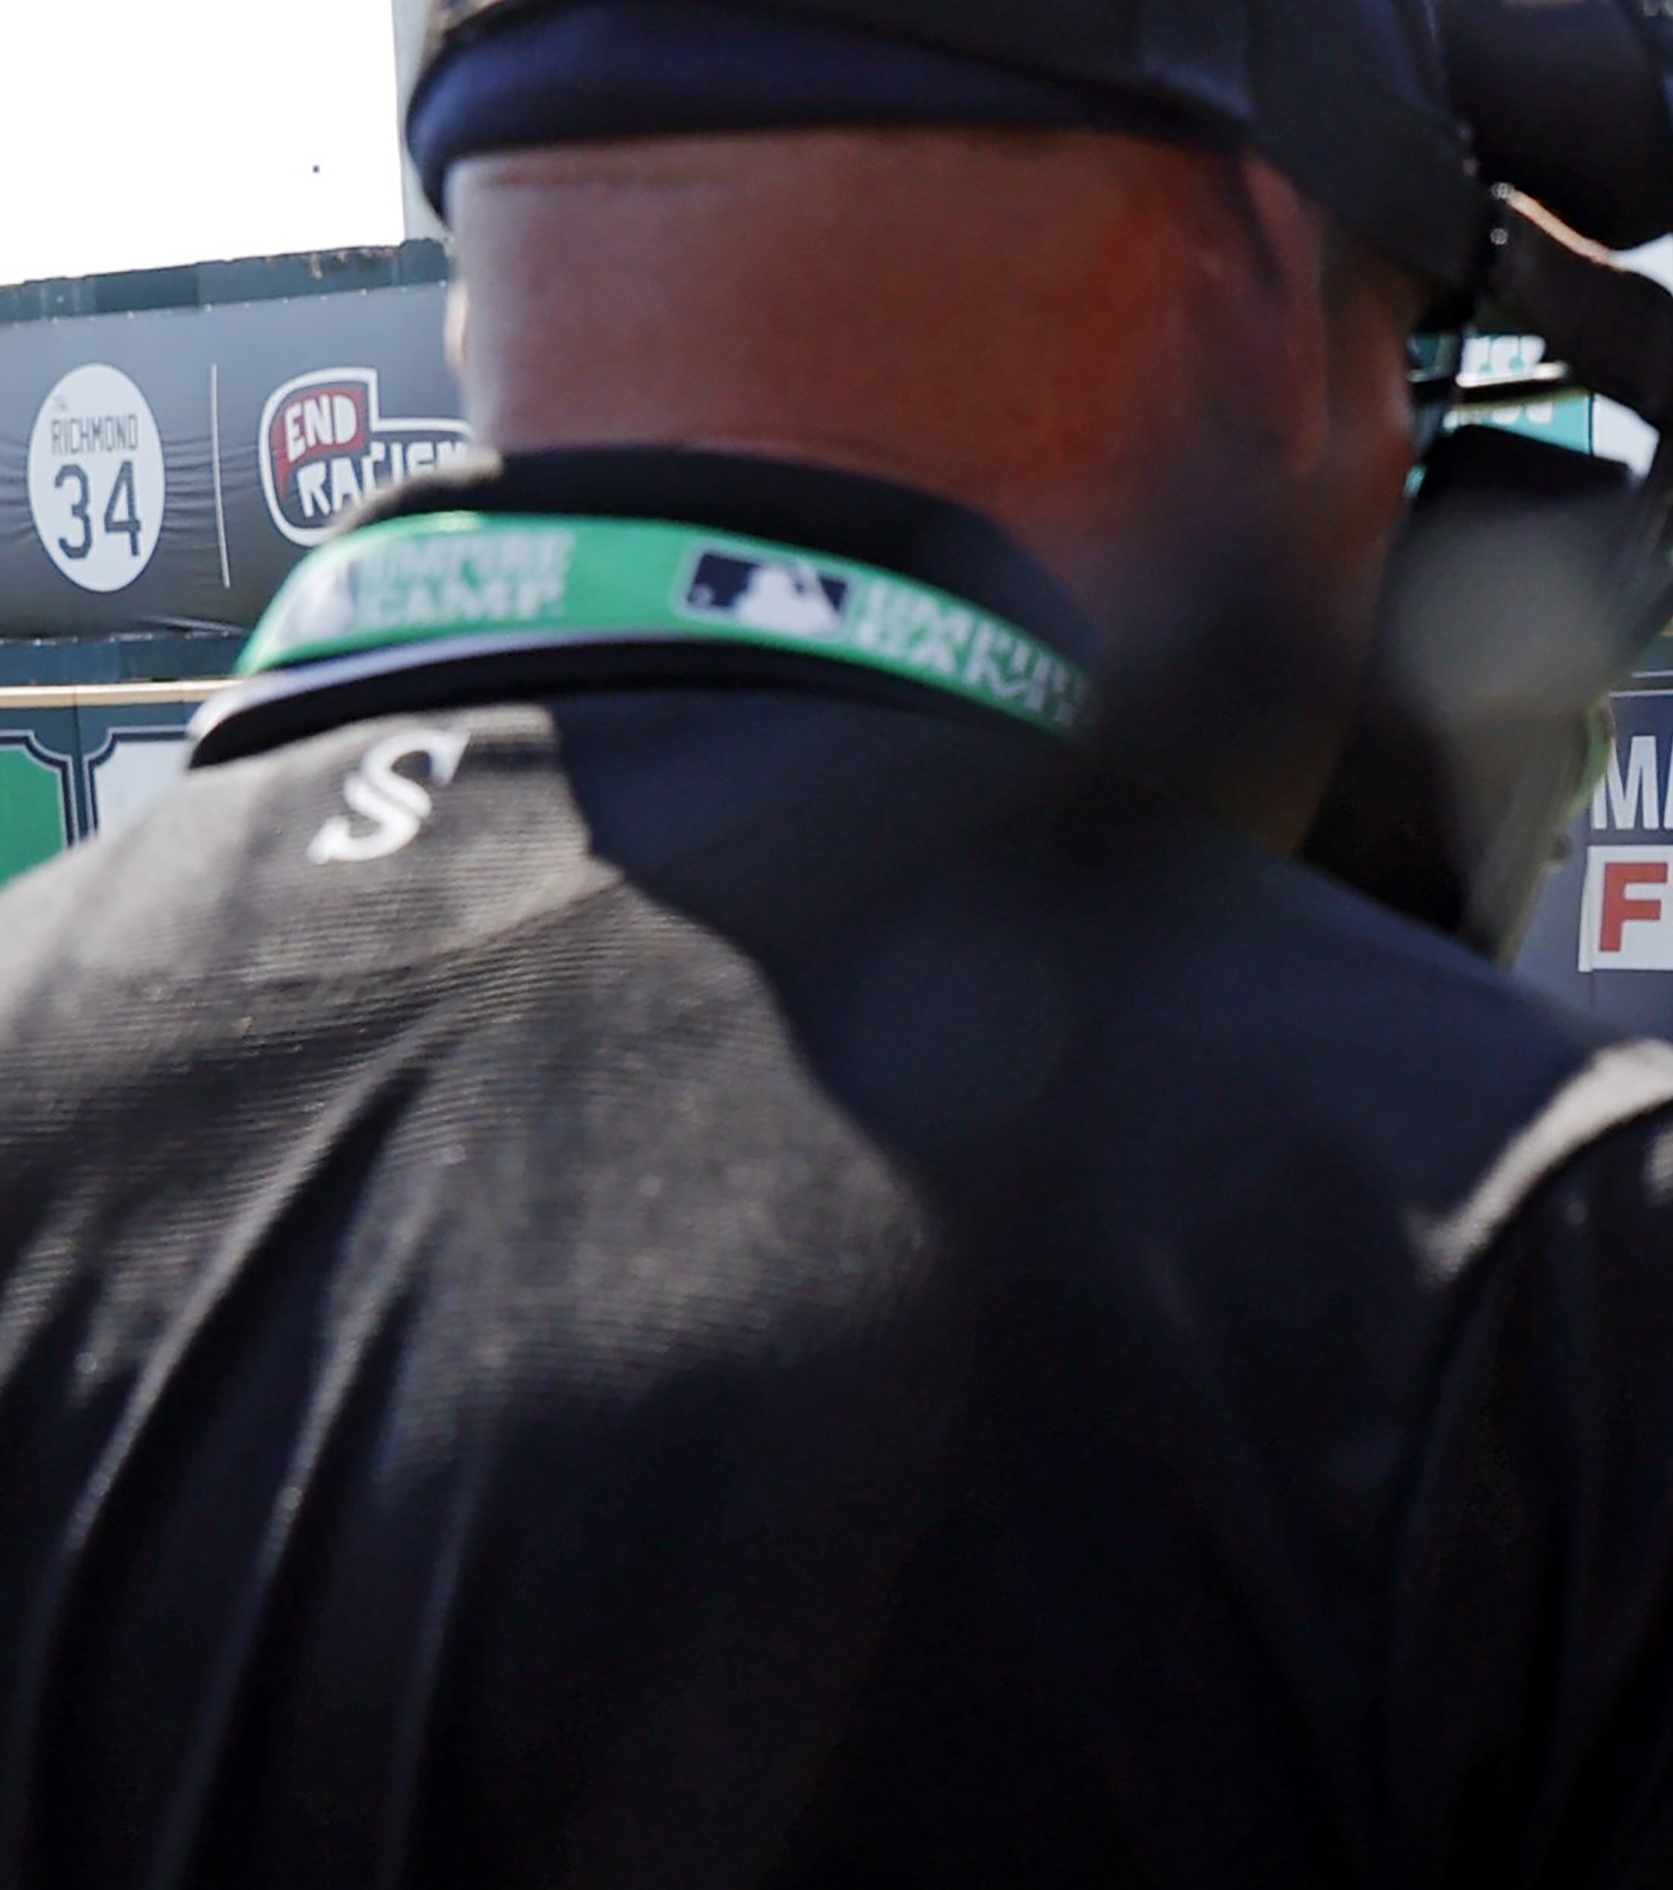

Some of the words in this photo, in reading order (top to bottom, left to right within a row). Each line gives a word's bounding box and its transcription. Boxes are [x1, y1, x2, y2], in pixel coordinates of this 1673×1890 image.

[51, 413, 139, 455] RICHMOND
[284, 394, 358, 463] END
[54, 460, 141, 560] 34
